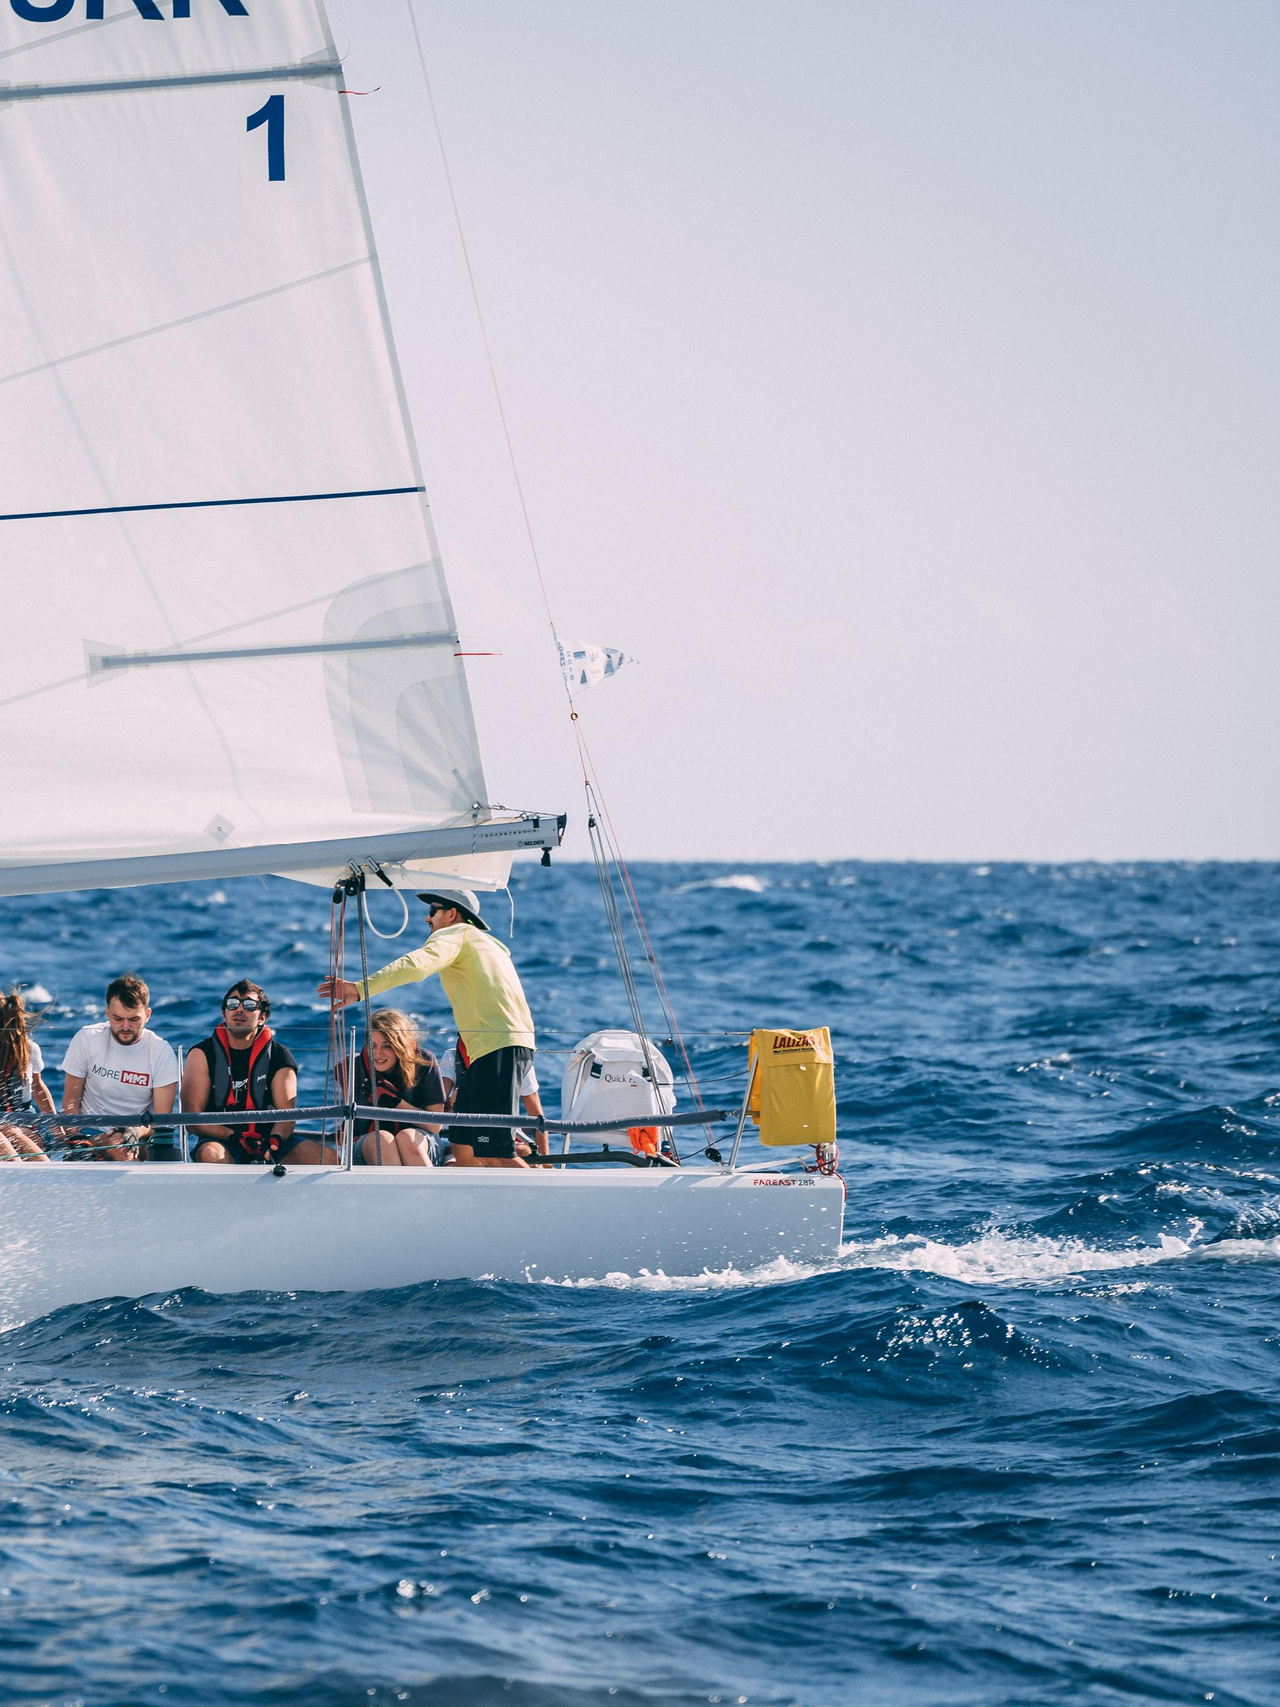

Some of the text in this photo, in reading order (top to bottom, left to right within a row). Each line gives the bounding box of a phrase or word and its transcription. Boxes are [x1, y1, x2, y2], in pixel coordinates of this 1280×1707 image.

[246, 95, 285, 181] 1
[92, 1064, 120, 1080] MORE
[604, 1073, 627, 1083] Quick
